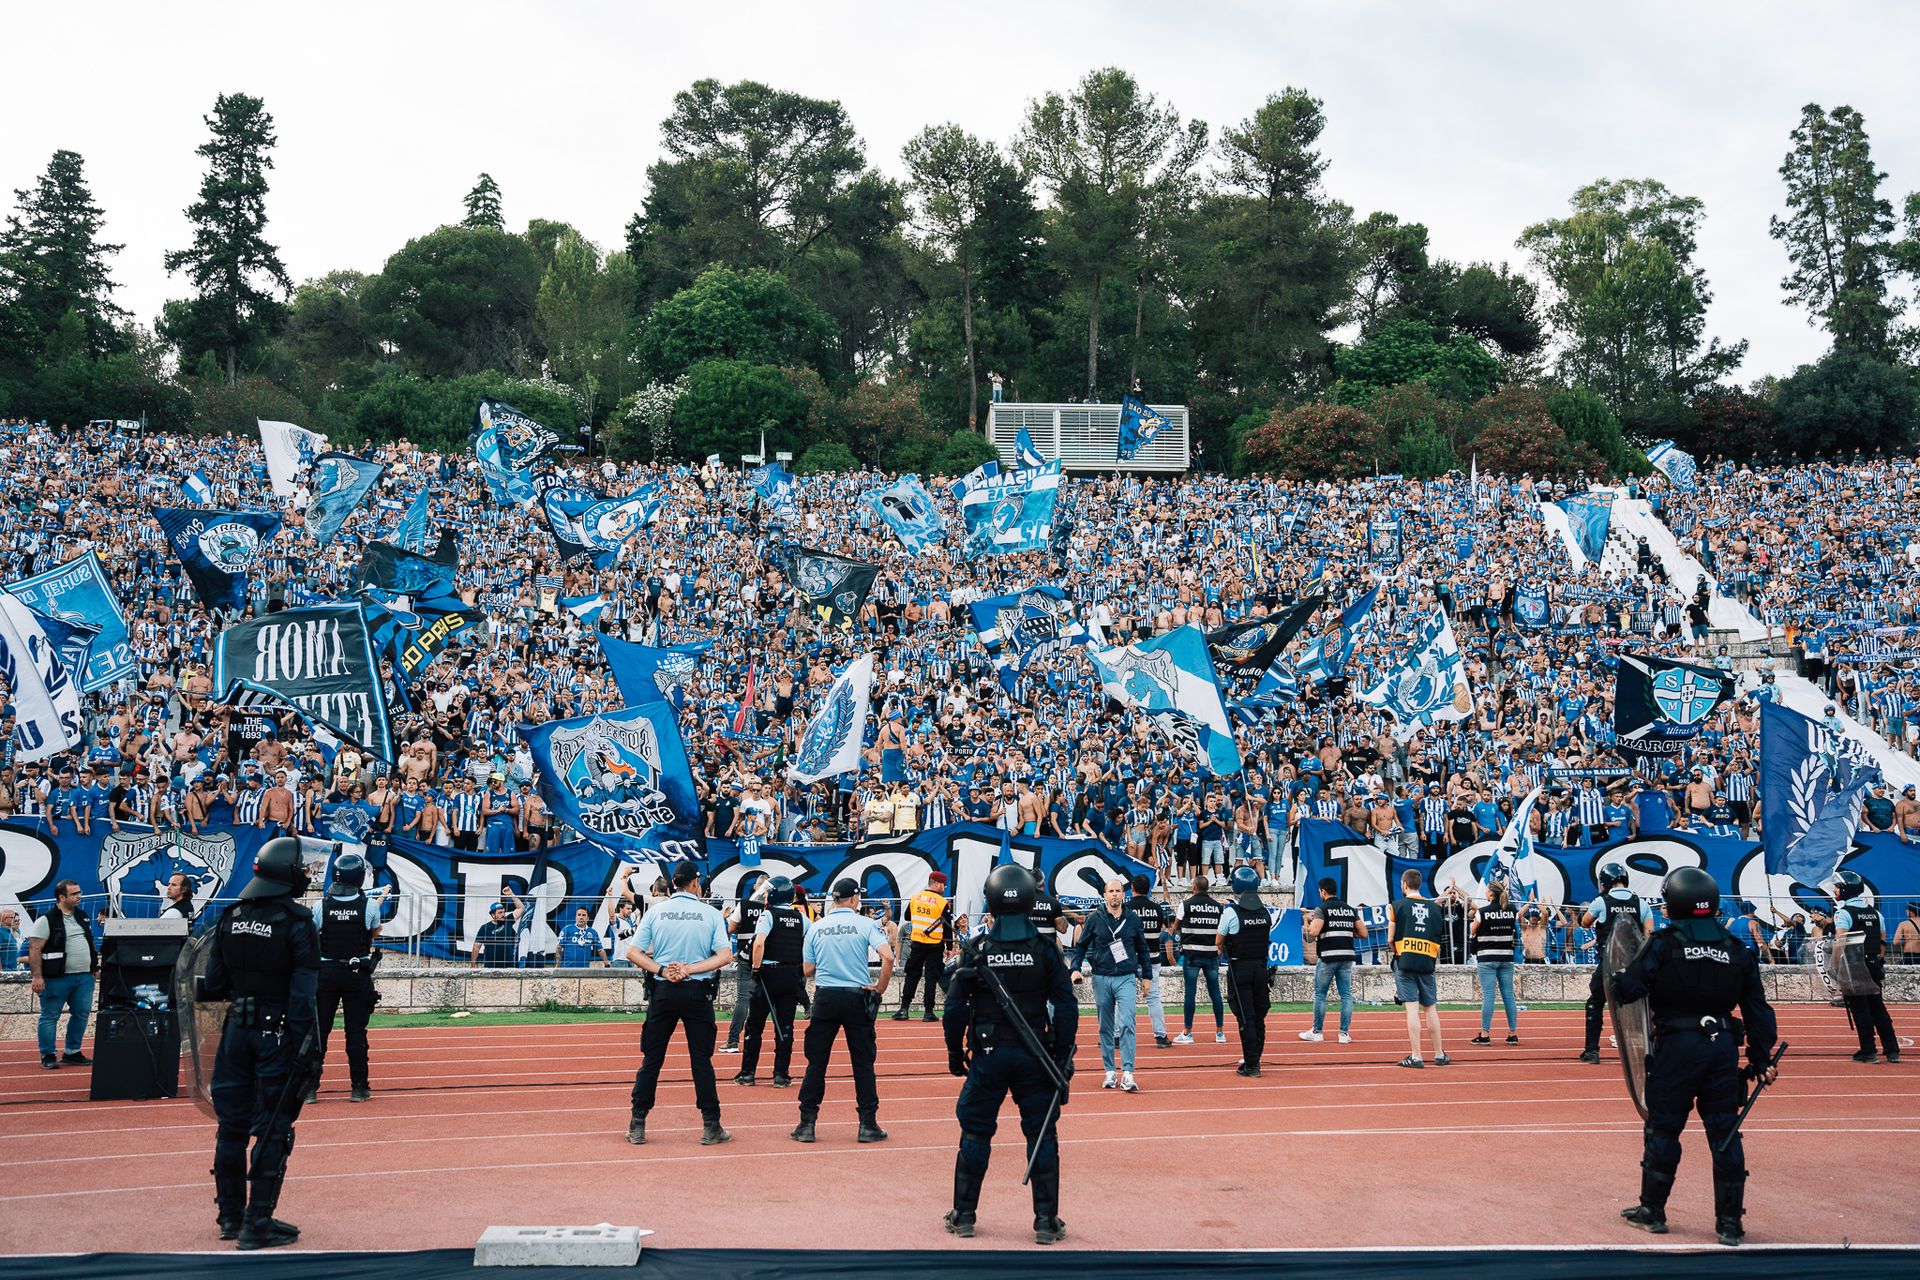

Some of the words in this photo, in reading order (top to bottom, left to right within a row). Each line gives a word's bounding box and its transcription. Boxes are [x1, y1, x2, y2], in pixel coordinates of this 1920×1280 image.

[1665, 674, 1678, 688] S
[1666, 702, 1678, 711] M
[1694, 700, 1704, 709] S
[244, 716, 263, 724] THE
[240, 731, 262, 739] 1893
[1593, 768, 1631, 776] RAMALDE
[370, 838, 386, 847] MEO
[743, 840, 758, 854] 30
[108, 837, 160, 871] SUPER
[1003, 889, 1018, 898] 493
[329, 908, 359, 916] POLÍCIA
[916, 906, 931, 915] 538
[1190, 903, 1220, 913] POLÍCIA
[1327, 907, 1355, 917] POLÍCIA
[1611, 905, 1637, 914] POLÍCIA
[660, 910, 703, 922] POLÍCIA
[1484, 909, 1515, 920] POLÍCIA
[779, 916, 801, 924] POLÍCIA
[1189, 917, 1219, 925] SPOTTERS
[1243, 918, 1267, 926] POLÍCIA
[1328, 920, 1354, 928] SPOTTERS
[231, 920, 273, 934] POLÍCIA
[817, 924, 858, 938] POLÍCIA
[987, 952, 1034, 963] POLÍCIA
[1684, 946, 1730, 960] POLÍCIA
